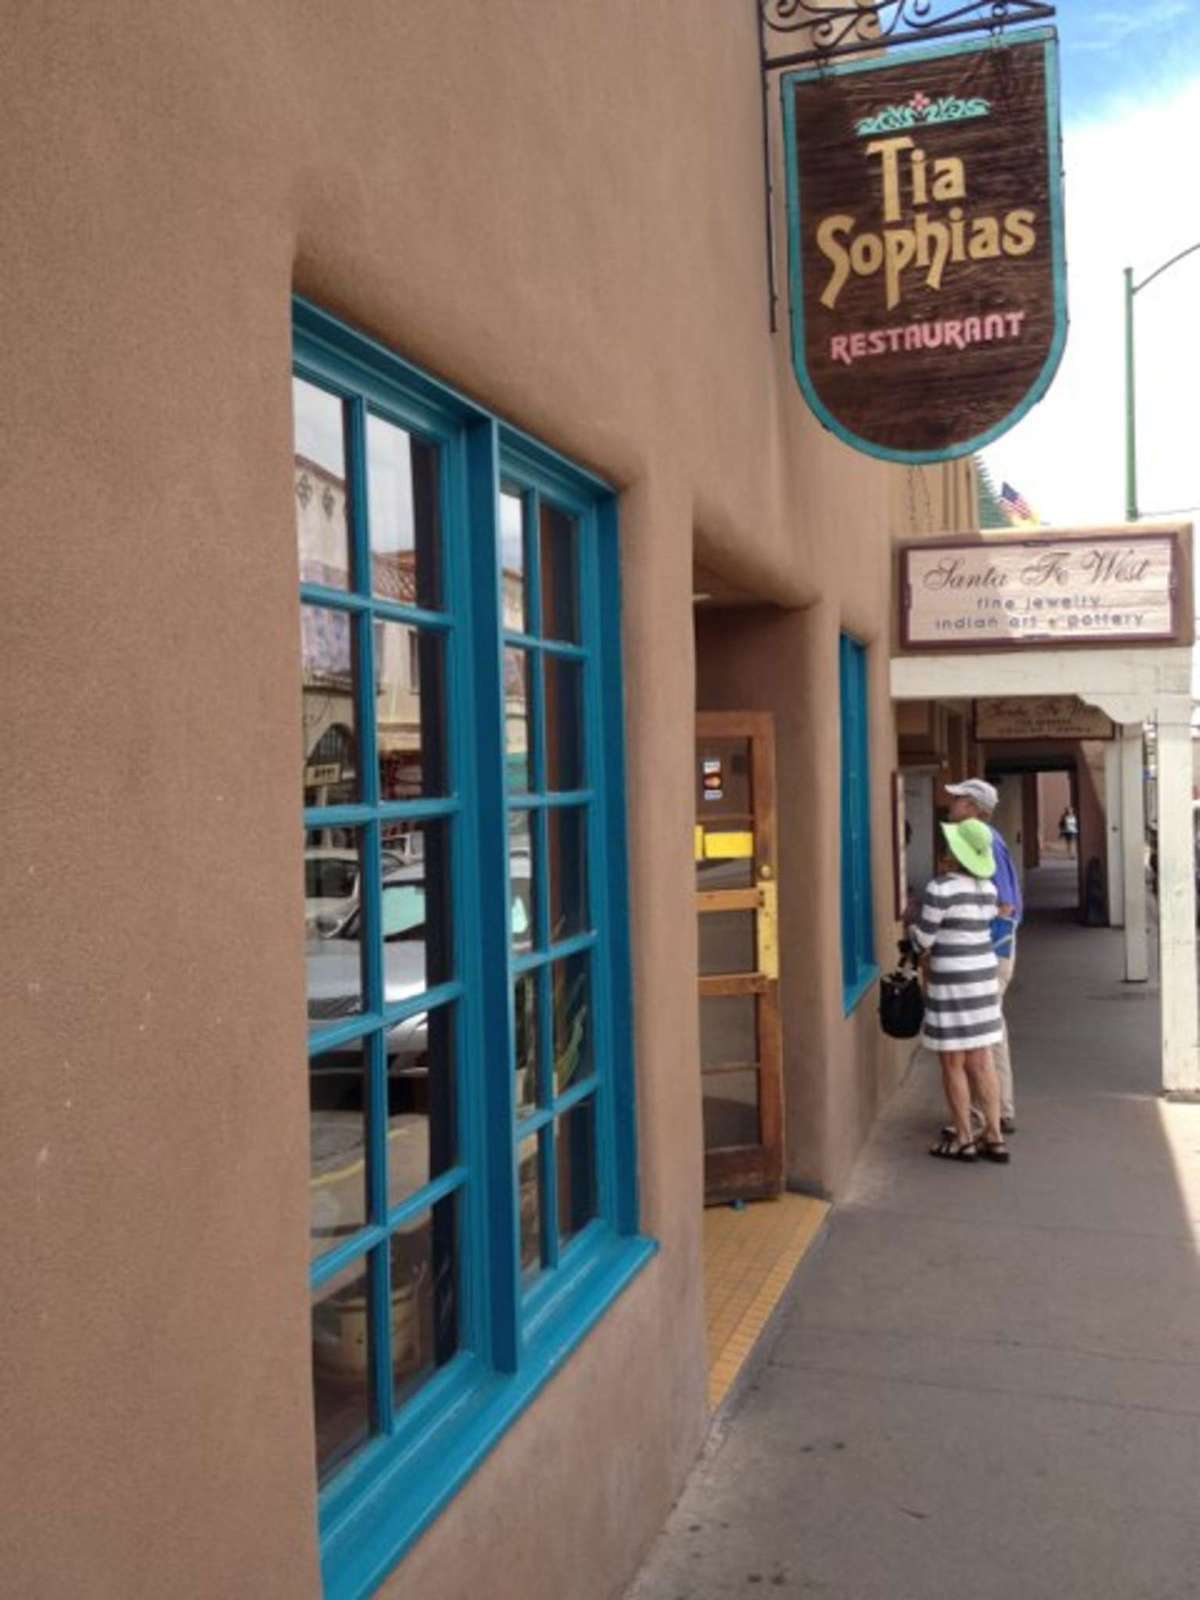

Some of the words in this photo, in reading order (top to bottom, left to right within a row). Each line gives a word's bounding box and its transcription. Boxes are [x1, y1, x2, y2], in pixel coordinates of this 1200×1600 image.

[866, 137, 967, 222] Tia
[816, 207, 1036, 311] Sophias
[831, 312, 1025, 363] RESTAURANT
[923, 556, 1009, 591] Santa
[1020, 552, 1070, 586] Fe
[1079, 549, 1150, 584] West
[935, 617, 998, 630] indian
[1009, 615, 1037, 628] art
[1067, 612, 1145, 629] pottery
[976, 596, 1015, 609] fine
